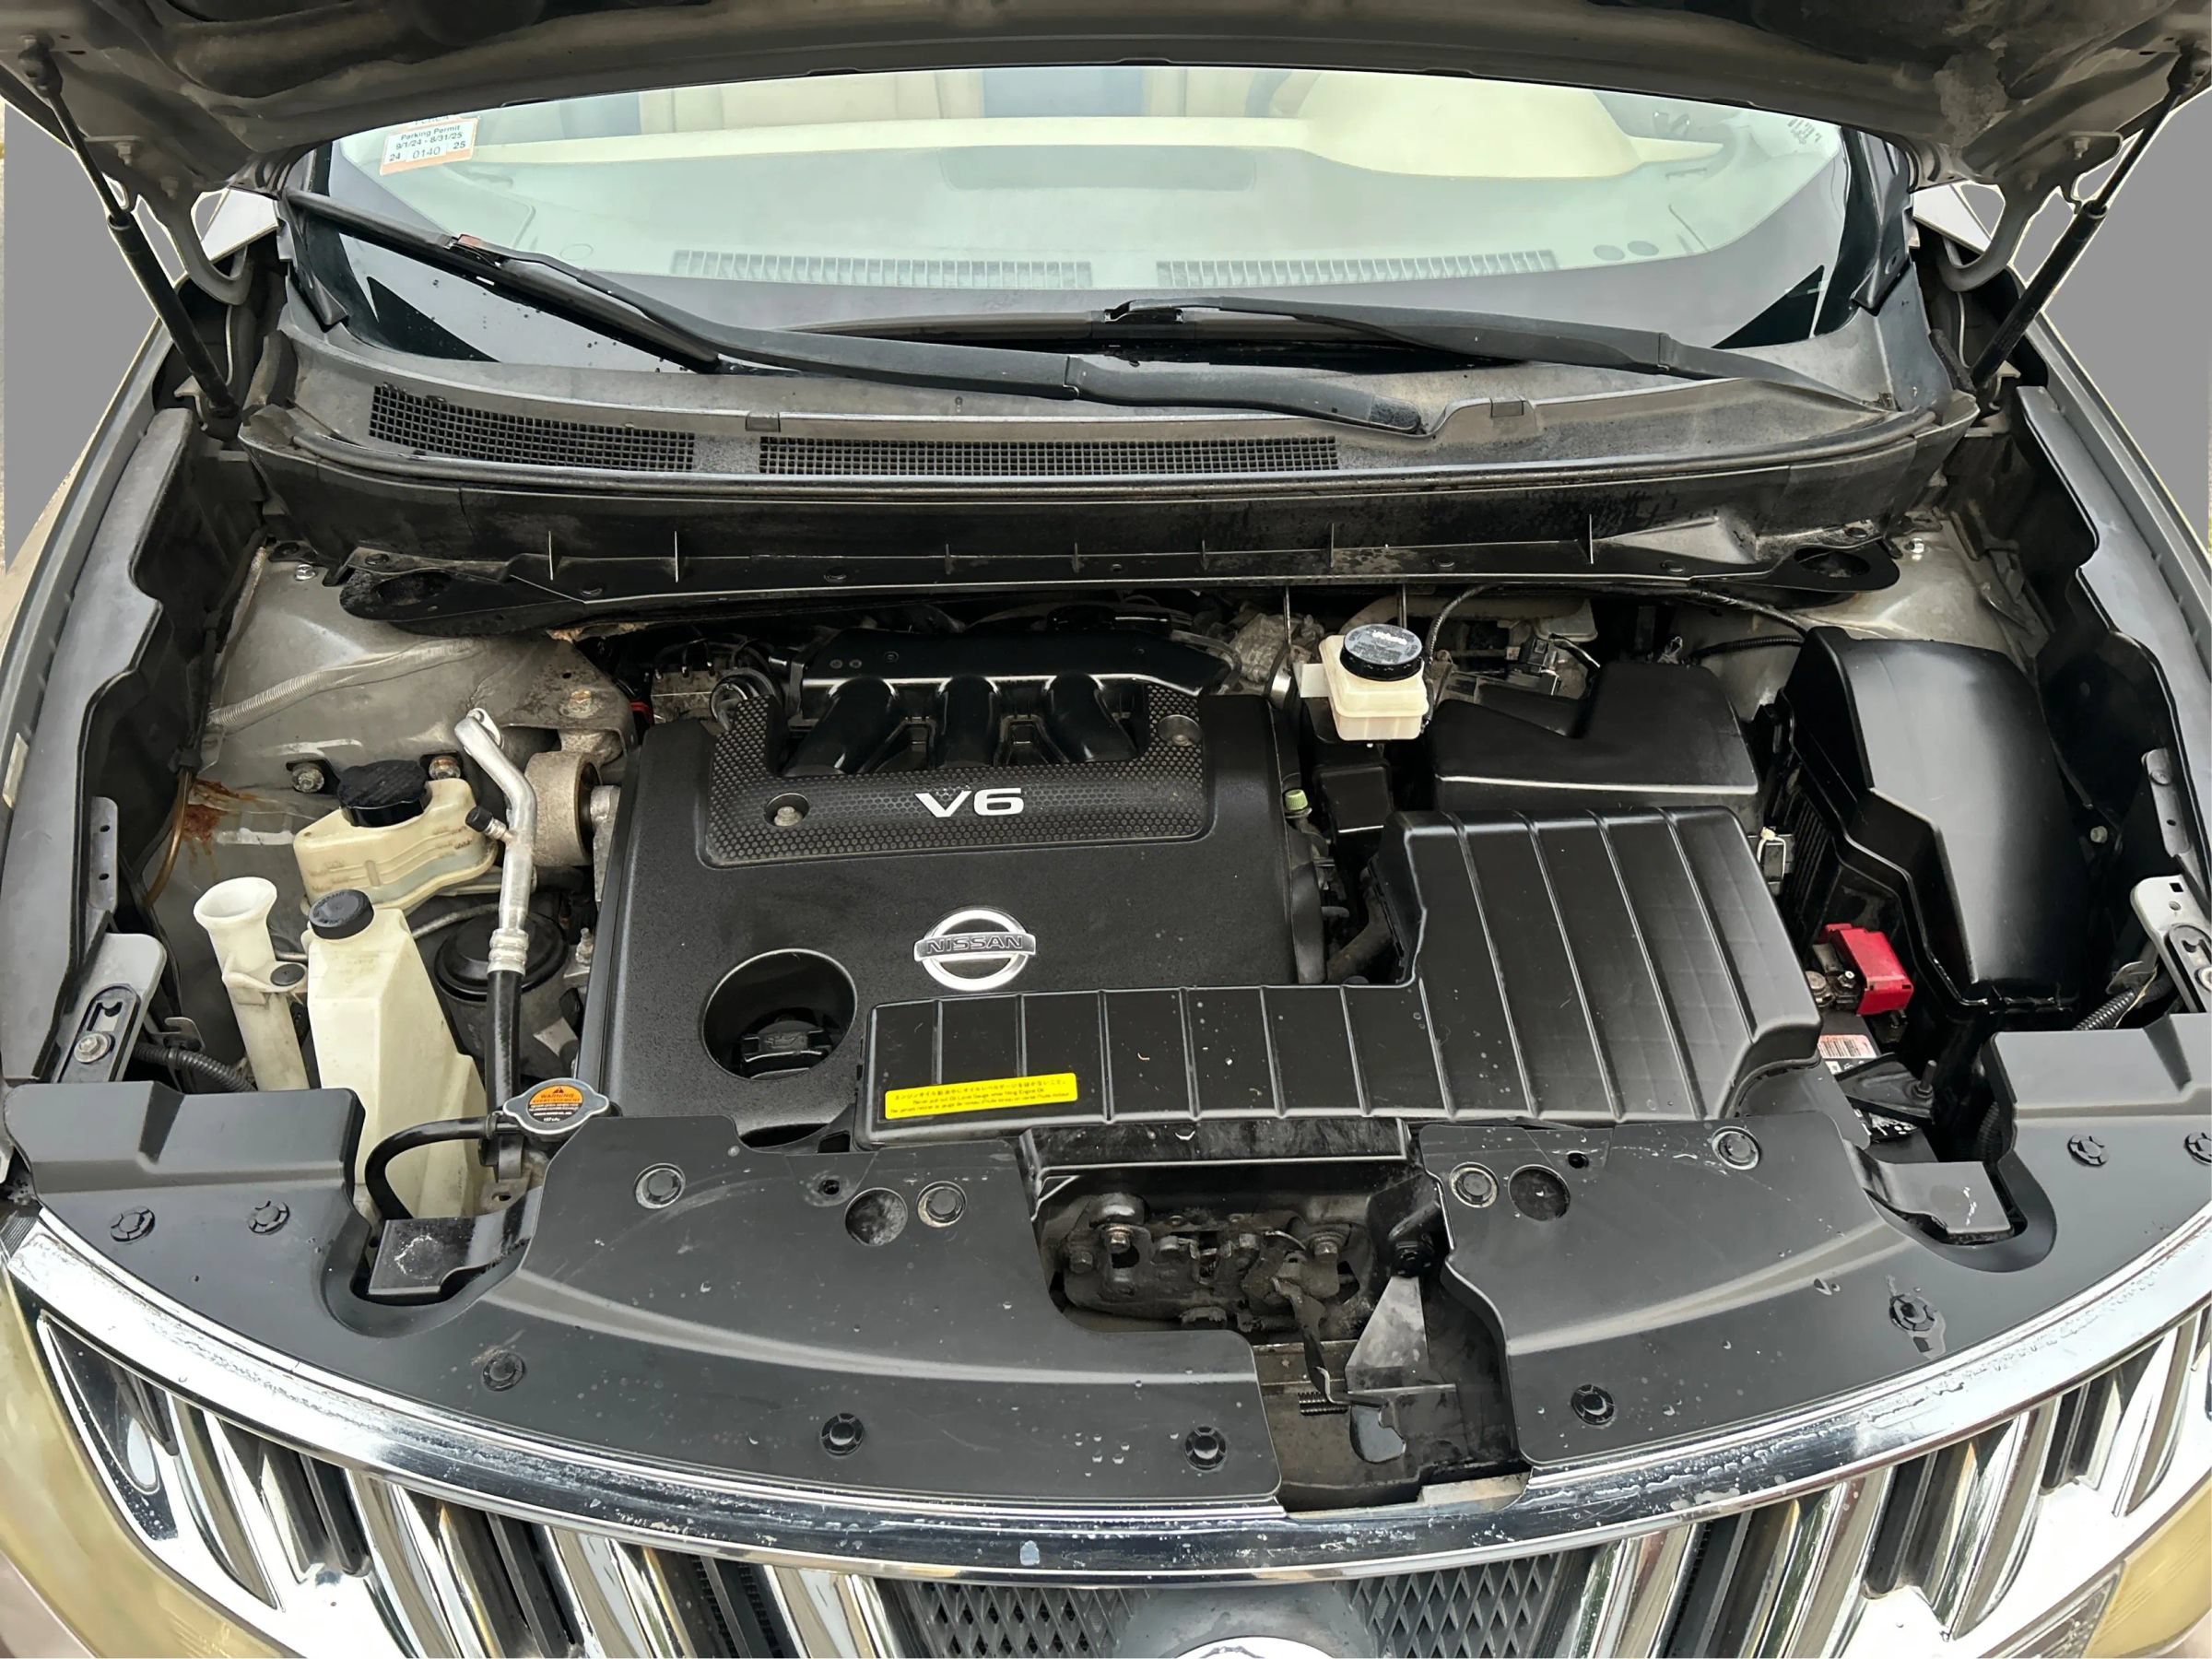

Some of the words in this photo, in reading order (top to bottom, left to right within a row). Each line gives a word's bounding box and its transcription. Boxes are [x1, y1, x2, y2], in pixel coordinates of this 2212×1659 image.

[395, 139, 421, 149] 9/1/24
[429, 133, 463, 143] 8/31/25
[401, 130, 431, 140] Parking
[434, 125, 461, 135] Permit
[389, 152, 401, 161] 24
[412, 147, 441, 159] 0140
[453, 141, 466, 149] 25
[914, 788, 1024, 818] V6
[926, 935, 1023, 954] NISSAN
